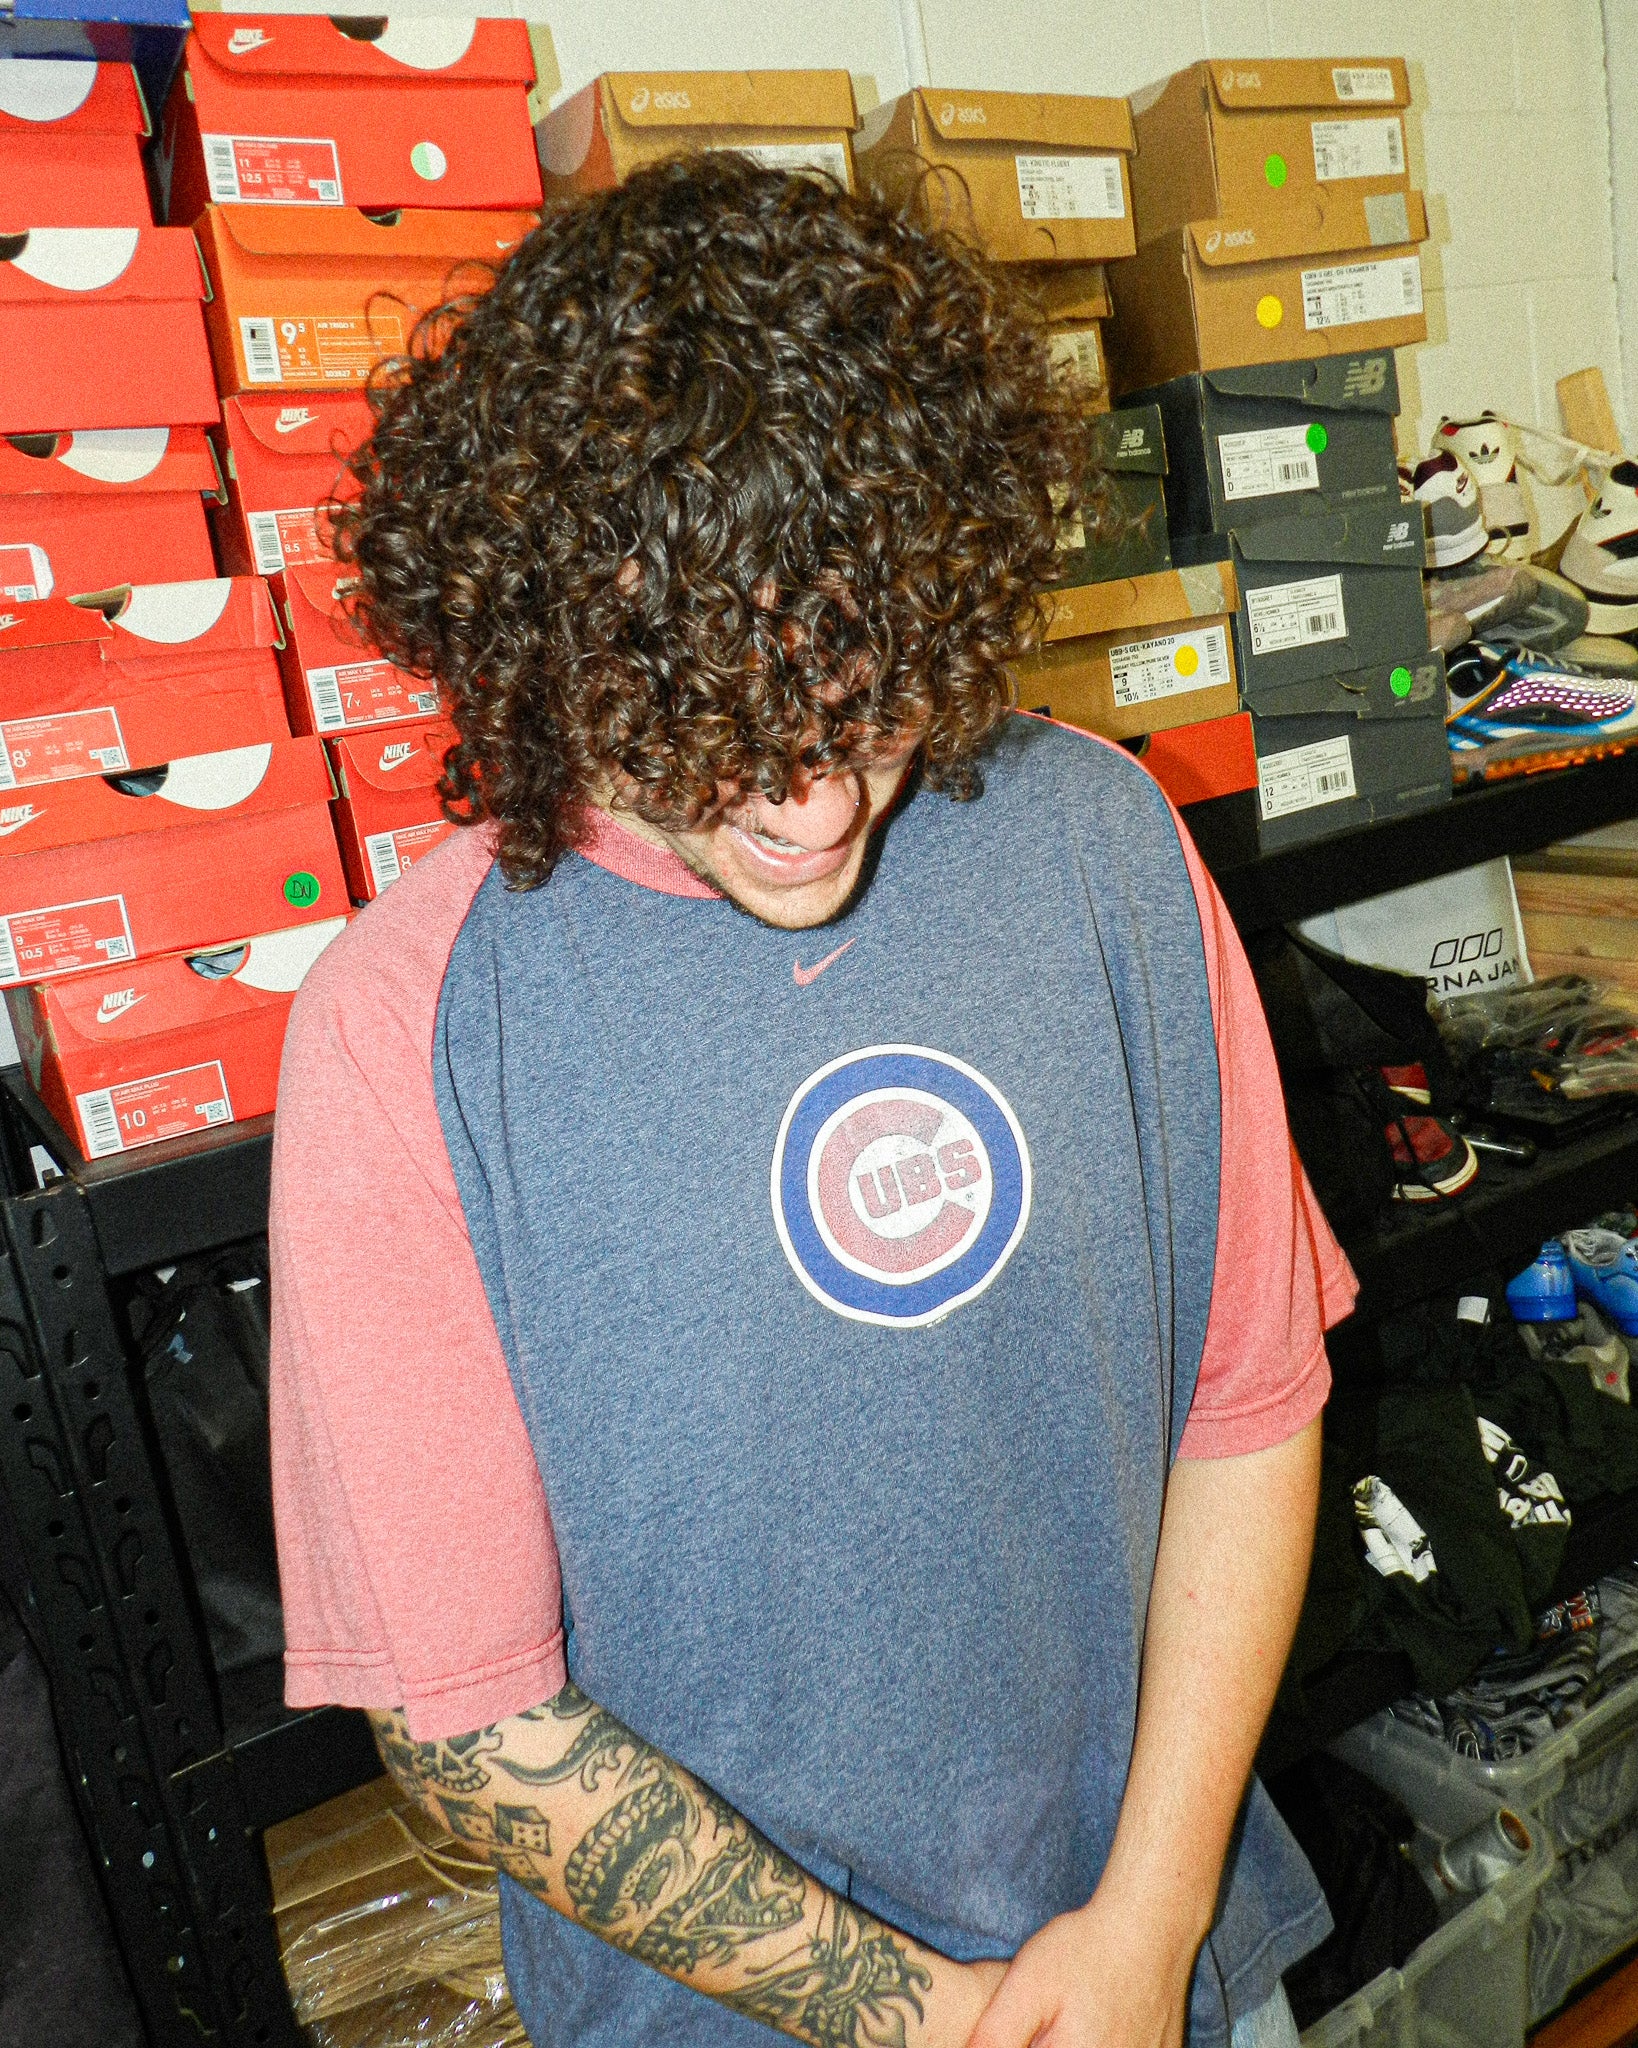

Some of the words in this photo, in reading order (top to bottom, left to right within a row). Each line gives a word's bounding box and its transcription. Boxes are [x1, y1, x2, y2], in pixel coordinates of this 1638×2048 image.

[234, 28, 264, 43] NIKE
[281, 408, 309, 423] NIKE
[1121, 678, 1128, 687] 9
[384, 742, 411, 760] NIKE
[0, 803, 33, 825] NIKE
[15, 935, 25, 946] 9
[20, 947, 44, 961] 10.5
[102, 988, 135, 1011] NIKE
[121, 1109, 147, 1130] 10
